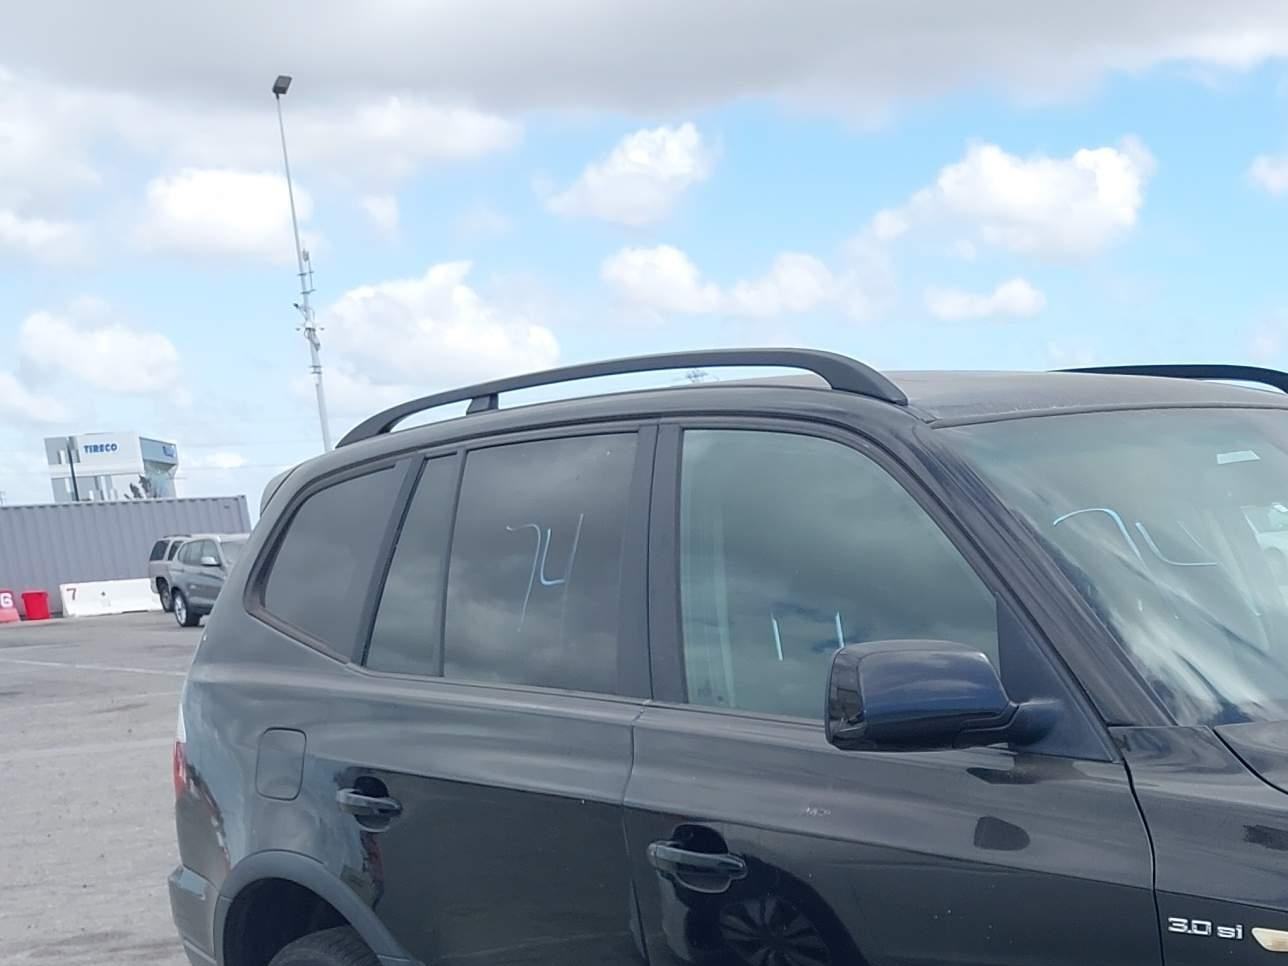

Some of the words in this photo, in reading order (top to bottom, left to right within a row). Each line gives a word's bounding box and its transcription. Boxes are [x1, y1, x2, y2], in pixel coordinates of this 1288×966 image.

[84, 444, 117, 454] TIRECO
[66, 588, 77, 600] 7
[1168, 917, 1212, 936] 3.0
[1217, 924, 1243, 939] si
